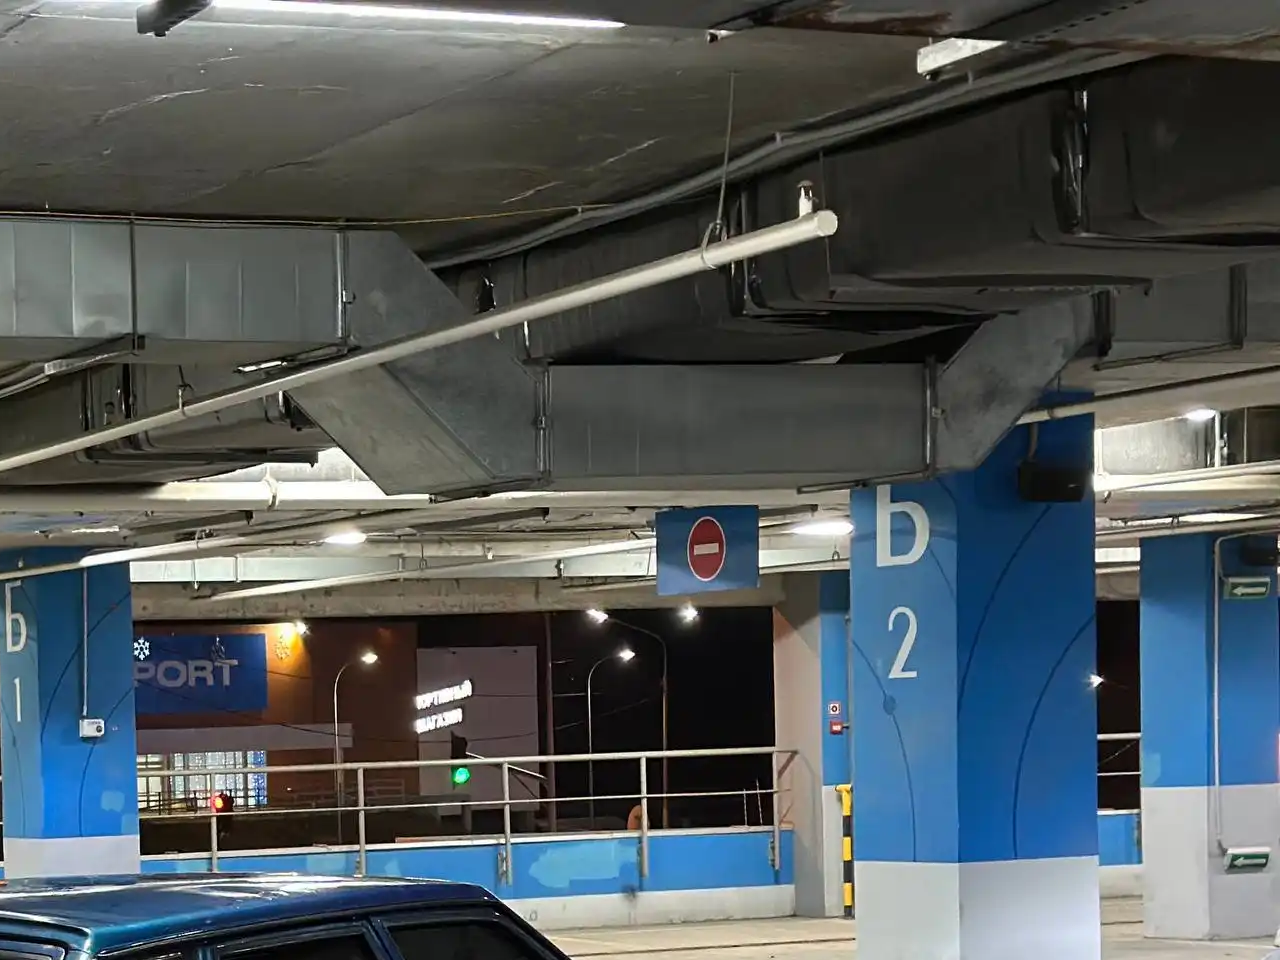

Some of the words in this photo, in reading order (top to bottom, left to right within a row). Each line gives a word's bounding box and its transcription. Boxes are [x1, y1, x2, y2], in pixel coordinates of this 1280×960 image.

[5, 580, 27, 653] Б
[888, 606, 918, 679] 2
[13, 677, 22, 722] 1
[133, 659, 239, 687] PORT
